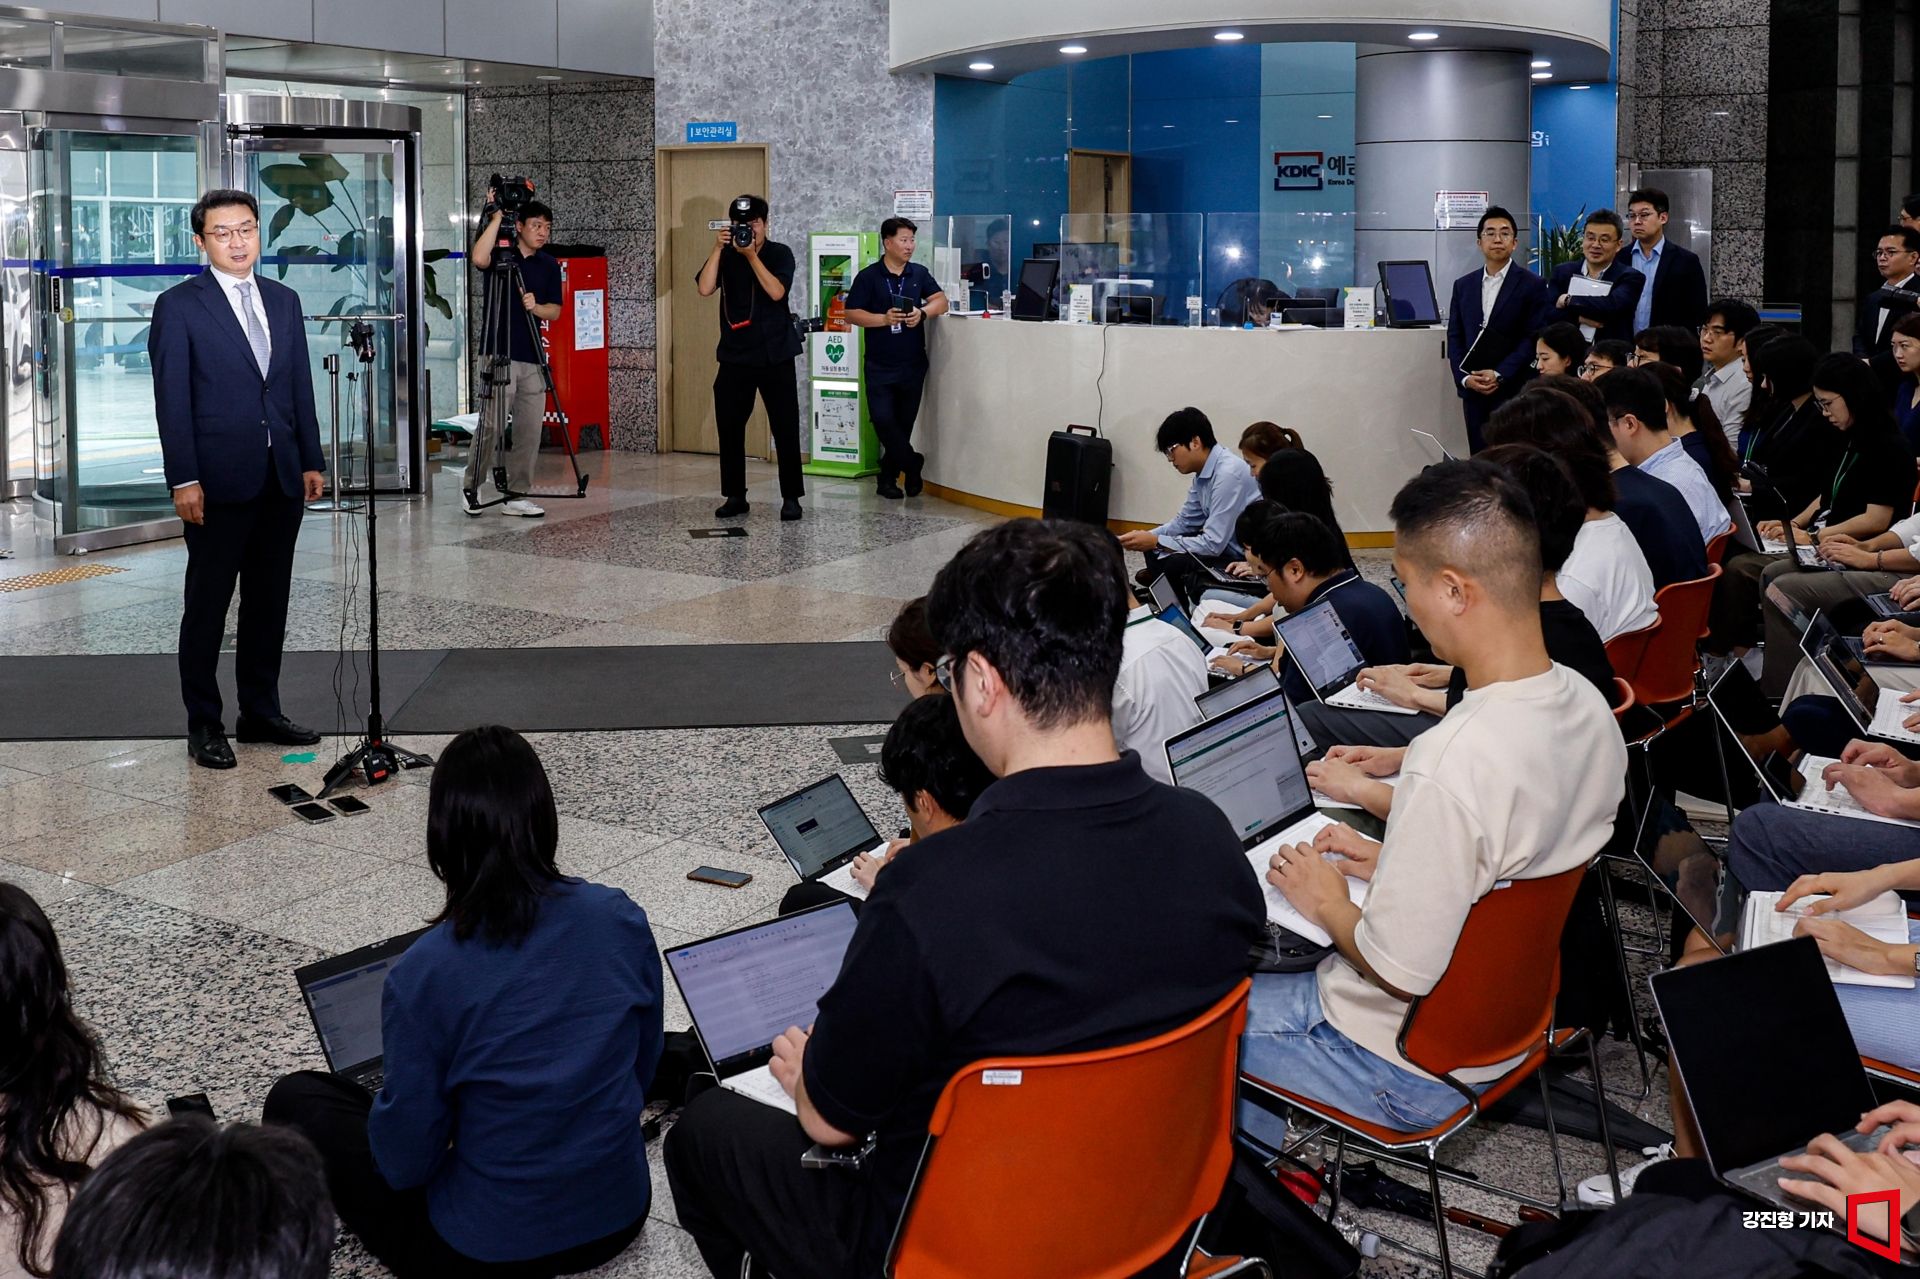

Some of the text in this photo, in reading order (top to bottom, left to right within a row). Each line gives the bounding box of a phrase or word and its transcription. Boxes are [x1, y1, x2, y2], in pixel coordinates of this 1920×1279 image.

[694, 126, 732, 138] 보안관리실
[1277, 165, 1320, 178] KDIC
[827, 335, 843, 344] AED
